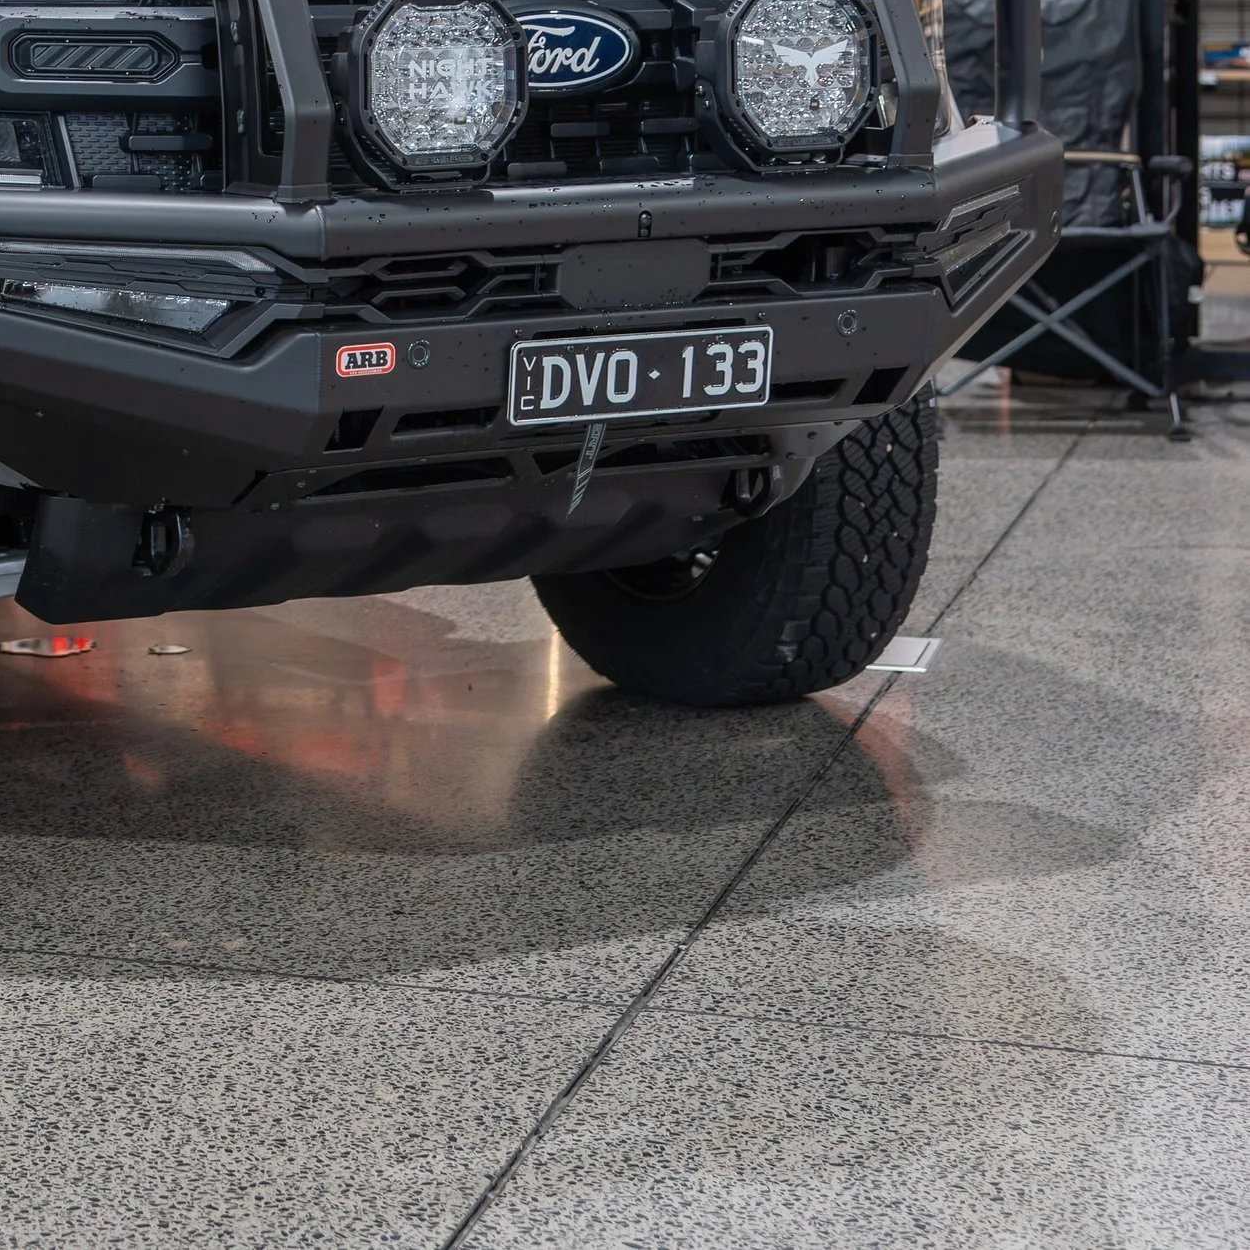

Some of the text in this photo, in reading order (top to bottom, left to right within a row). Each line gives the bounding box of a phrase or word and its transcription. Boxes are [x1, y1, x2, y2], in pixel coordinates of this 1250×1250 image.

[521, 24, 602, 75] Ford
[409, 57, 494, 79] NIGHT
[408, 81, 493, 101] HAWK
[344, 350, 389, 370] ARB
[539, 340, 766, 410] DVO 133
